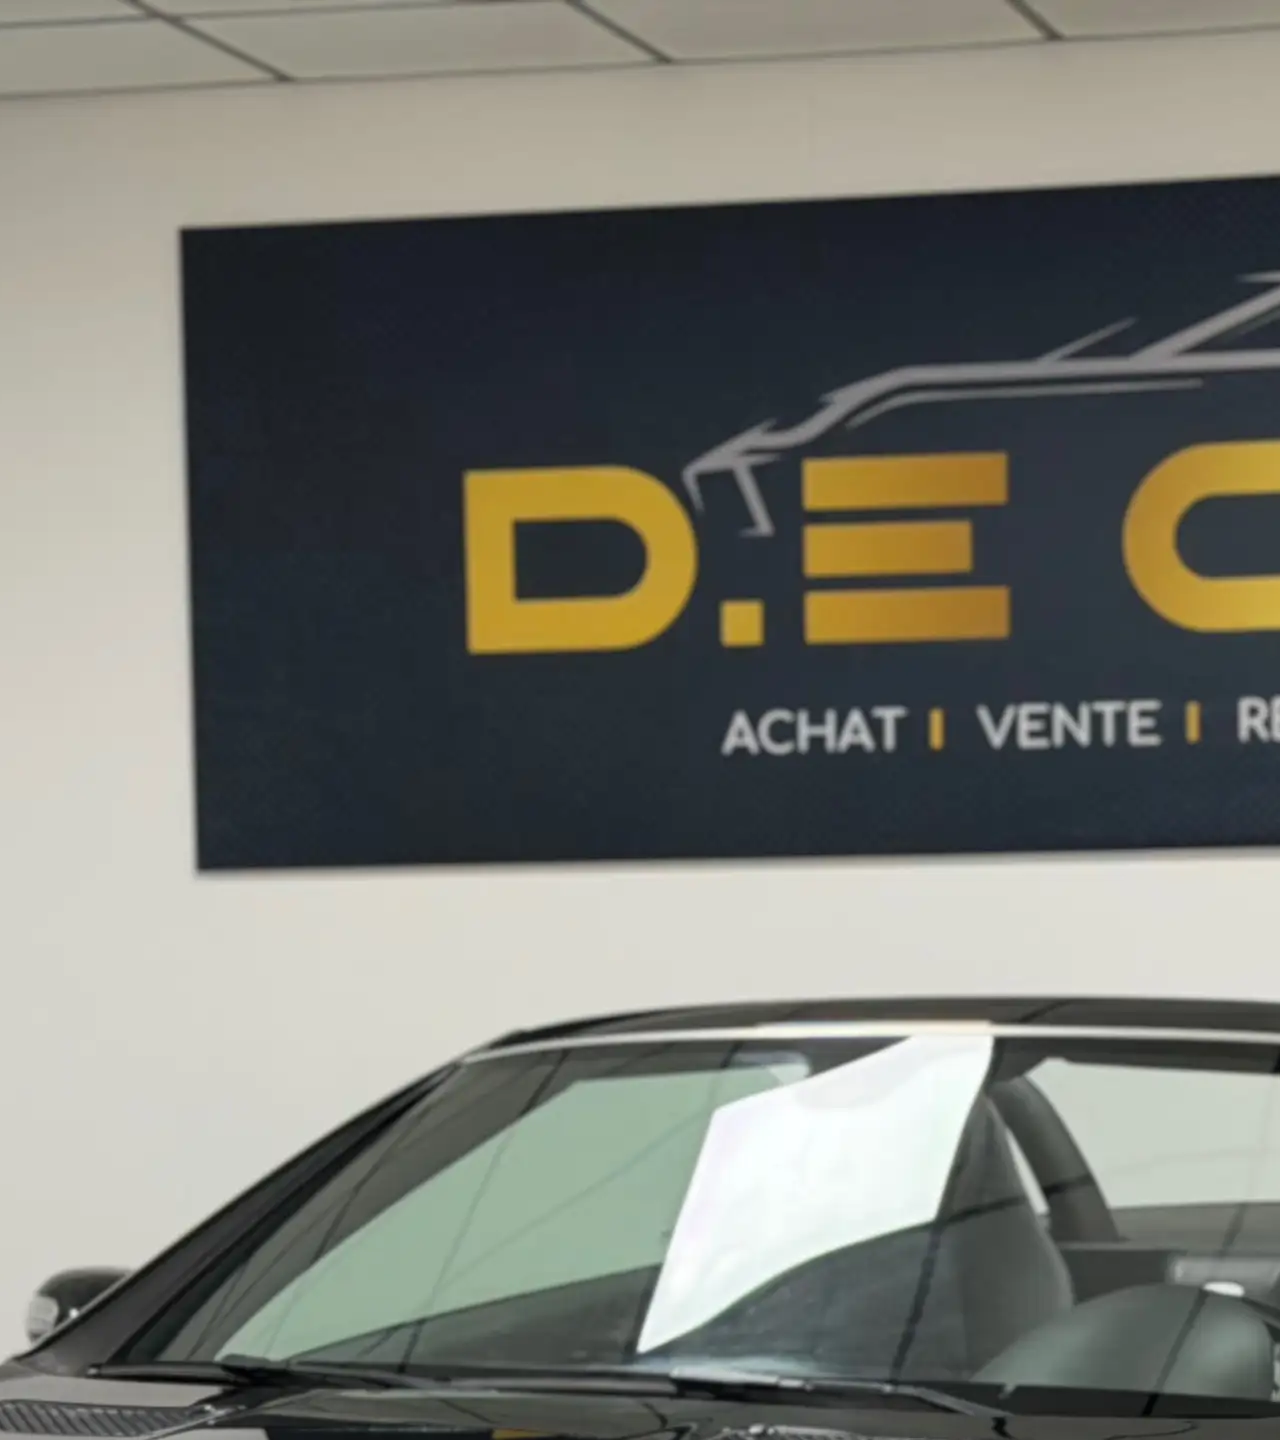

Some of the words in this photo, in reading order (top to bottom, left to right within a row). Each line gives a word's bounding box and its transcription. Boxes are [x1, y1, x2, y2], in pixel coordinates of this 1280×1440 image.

[463, 452, 1010, 656] D.E
[720, 705, 908, 755] ACHAT
[976, 699, 1163, 750] VENTE
